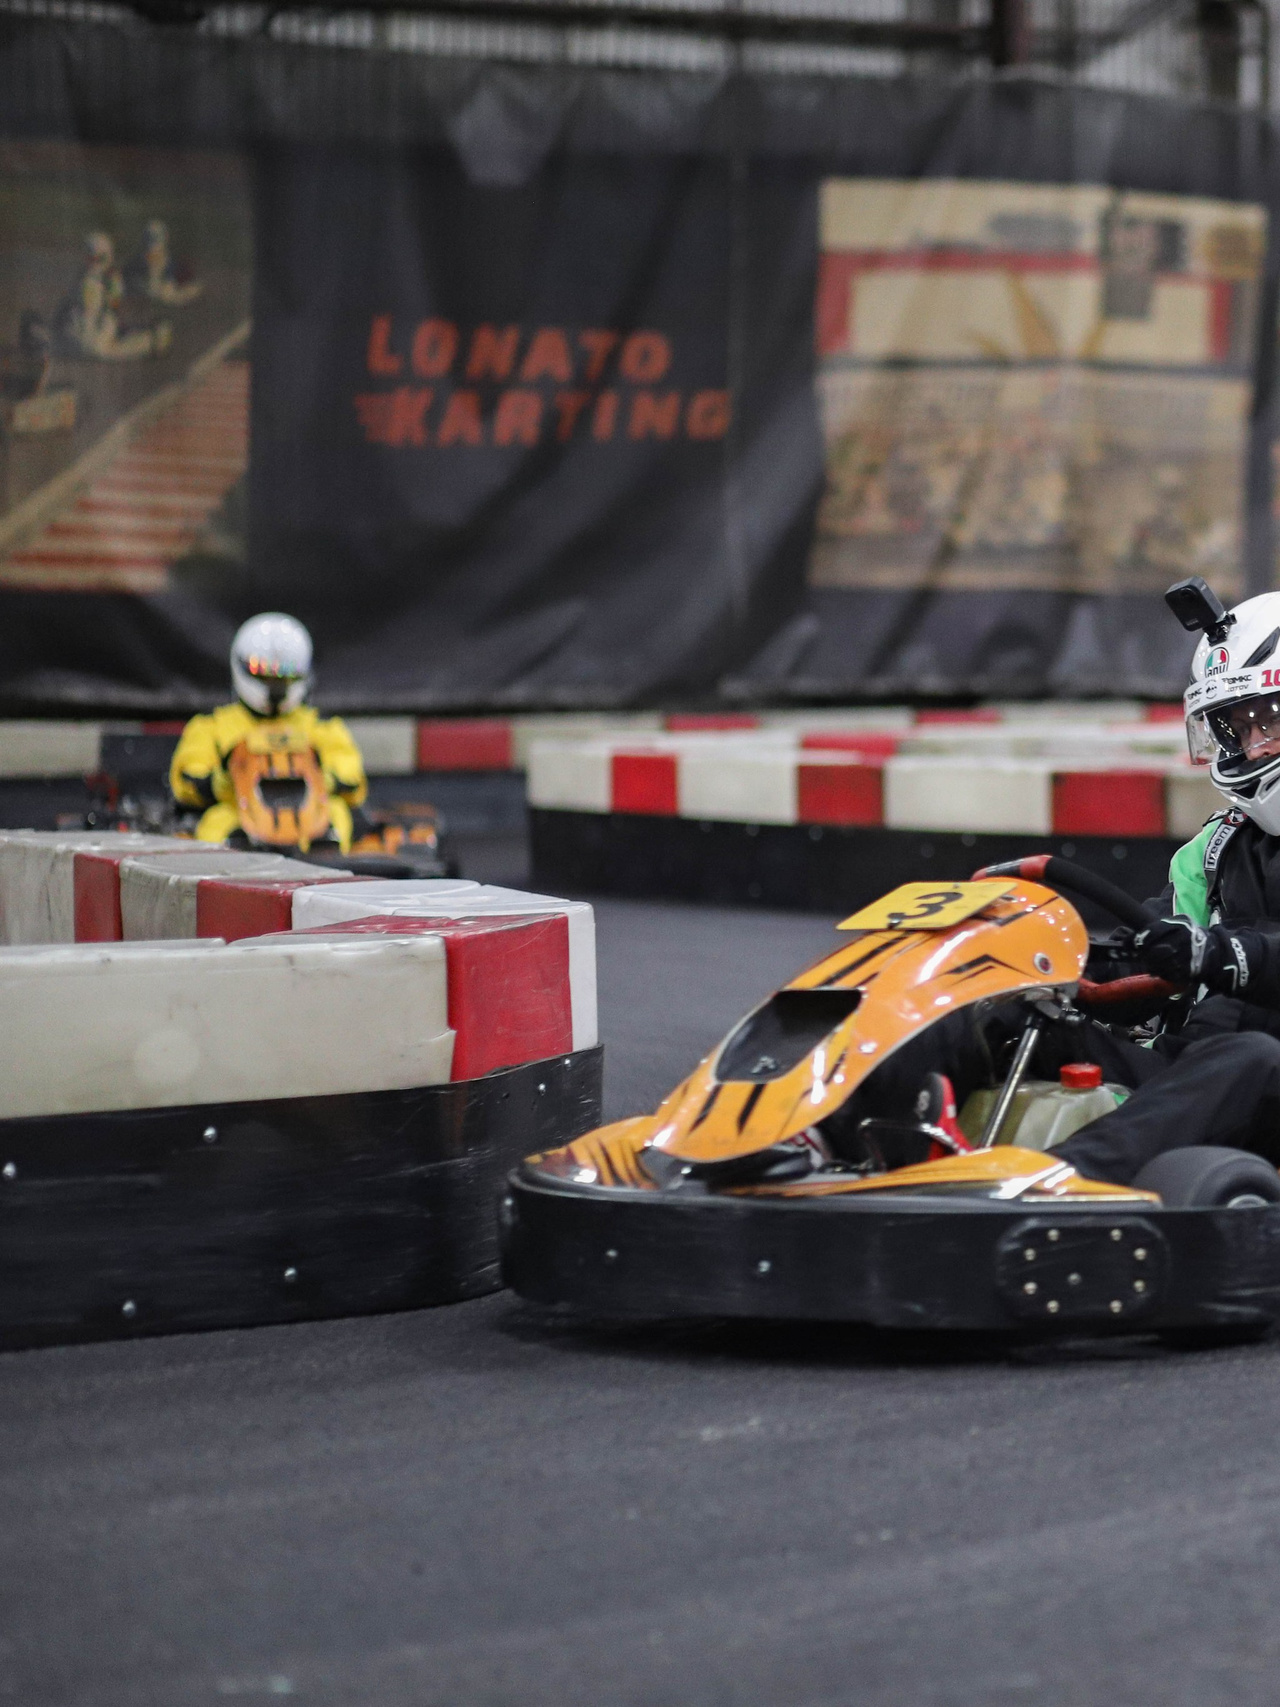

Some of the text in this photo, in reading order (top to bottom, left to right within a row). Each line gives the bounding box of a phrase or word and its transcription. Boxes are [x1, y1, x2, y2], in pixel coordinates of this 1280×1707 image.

[366, 313, 674, 385] LONATO
[359, 387, 734, 448] KARTING
[887, 891, 964, 919] 3
